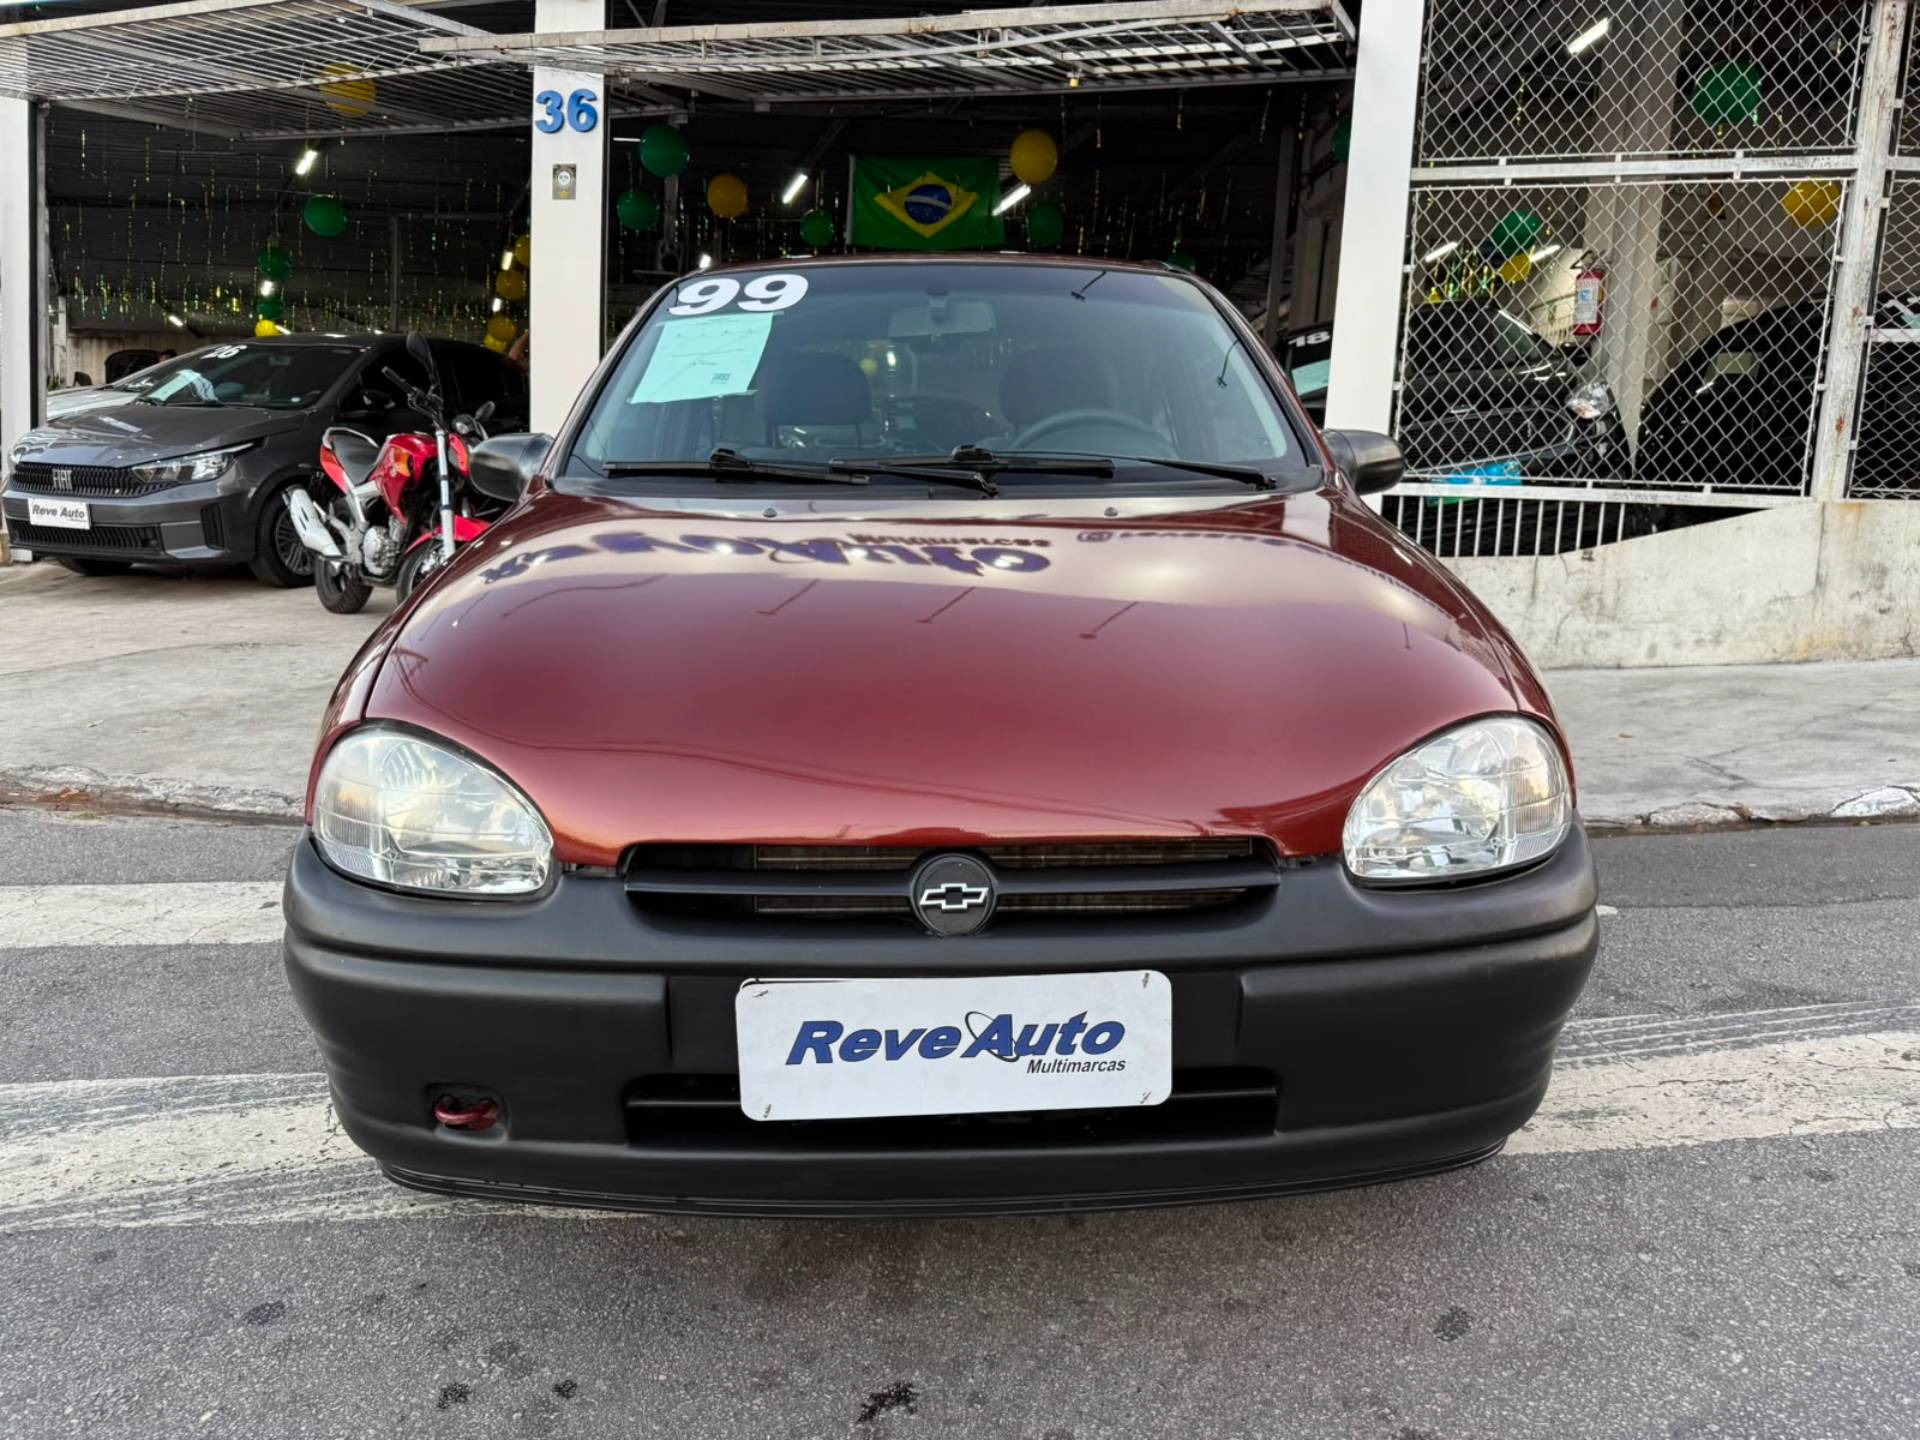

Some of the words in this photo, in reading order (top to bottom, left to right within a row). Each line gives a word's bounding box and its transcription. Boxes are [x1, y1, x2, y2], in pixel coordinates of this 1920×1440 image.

[535, 88, 598, 134] 36
[668, 273, 809, 316] 99
[1287, 331, 1331, 348] 18
[60, 507, 85, 519] Auto
[785, 1020, 962, 1066] Reve
[960, 1010, 1126, 1059] Auto
[1026, 1058, 1127, 1074] Multimarcas
